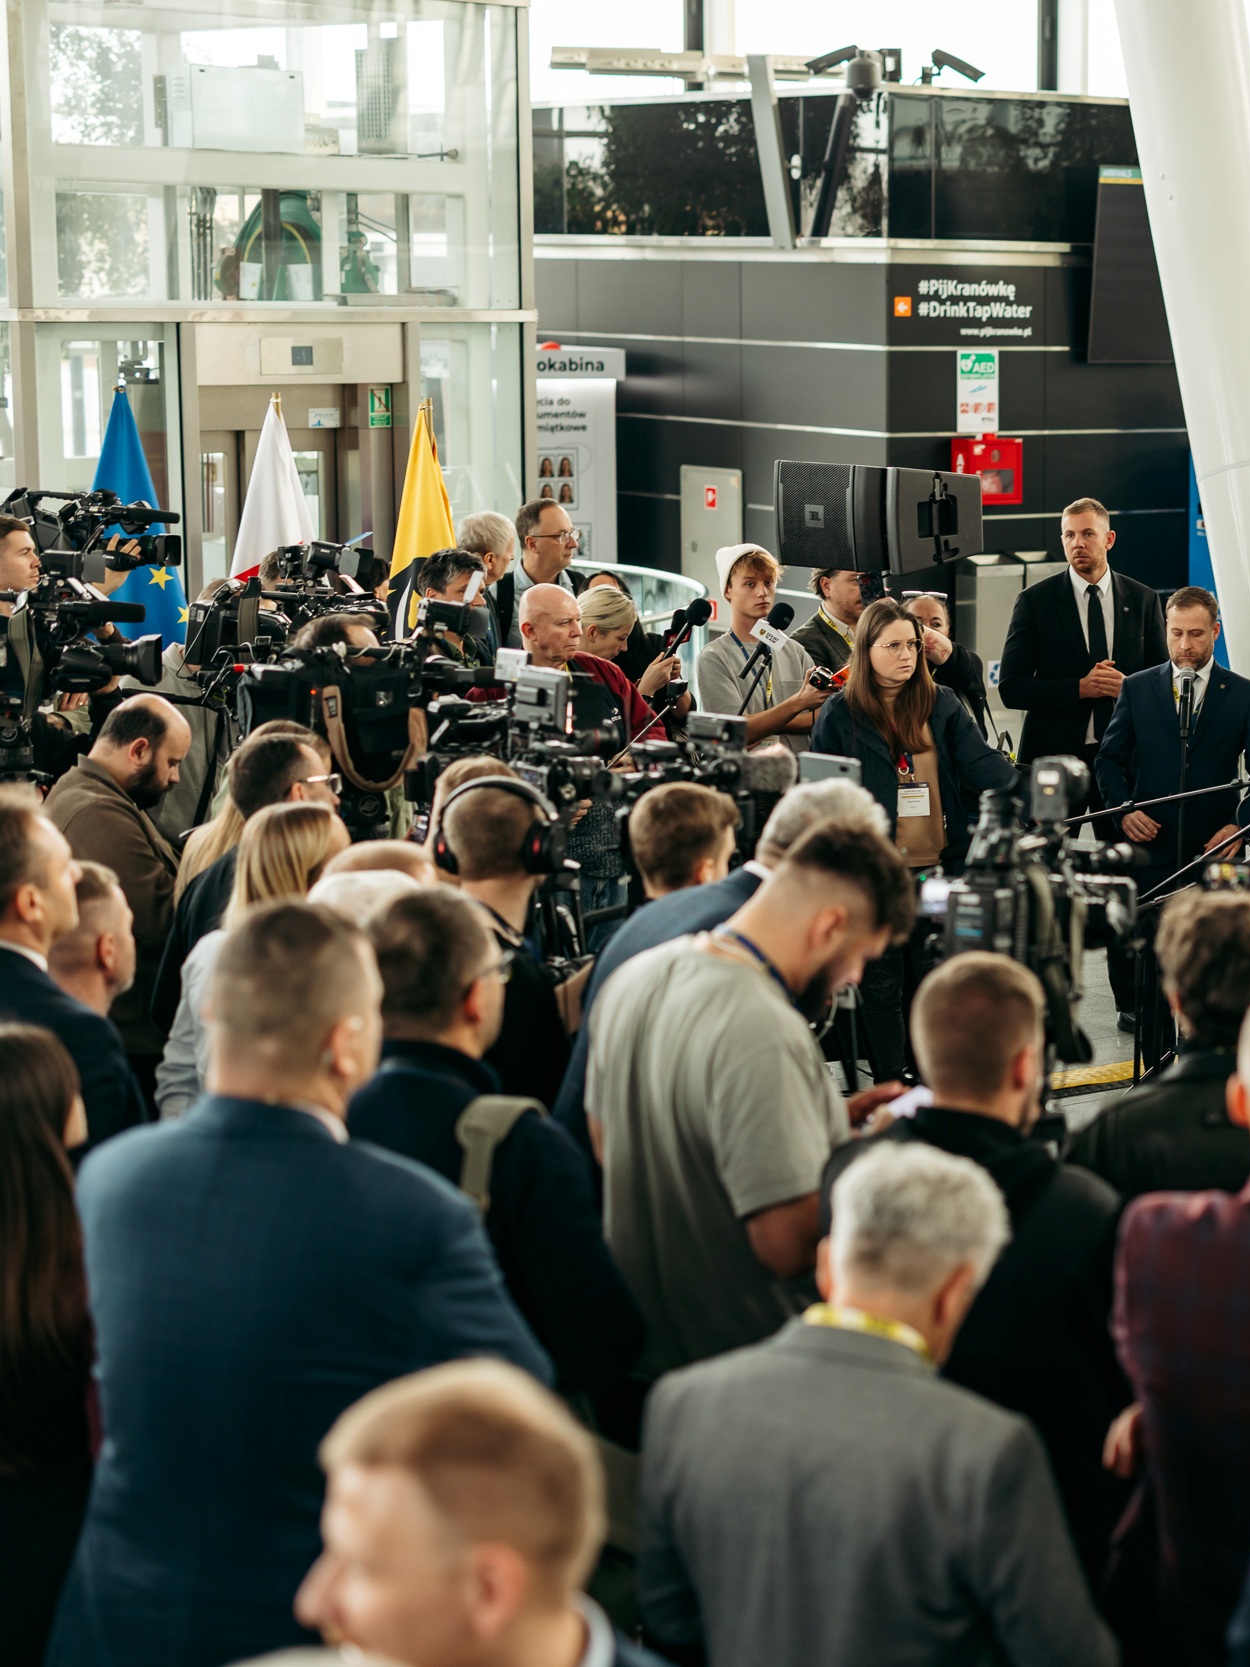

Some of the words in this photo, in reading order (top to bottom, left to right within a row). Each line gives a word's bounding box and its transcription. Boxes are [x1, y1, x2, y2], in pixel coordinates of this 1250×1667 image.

[917, 279, 1016, 301] #PijKranówkę
[917, 301, 1033, 322] #DrinkTapWater
[536, 357, 604, 372] okabina
[972, 361, 996, 373] AED
